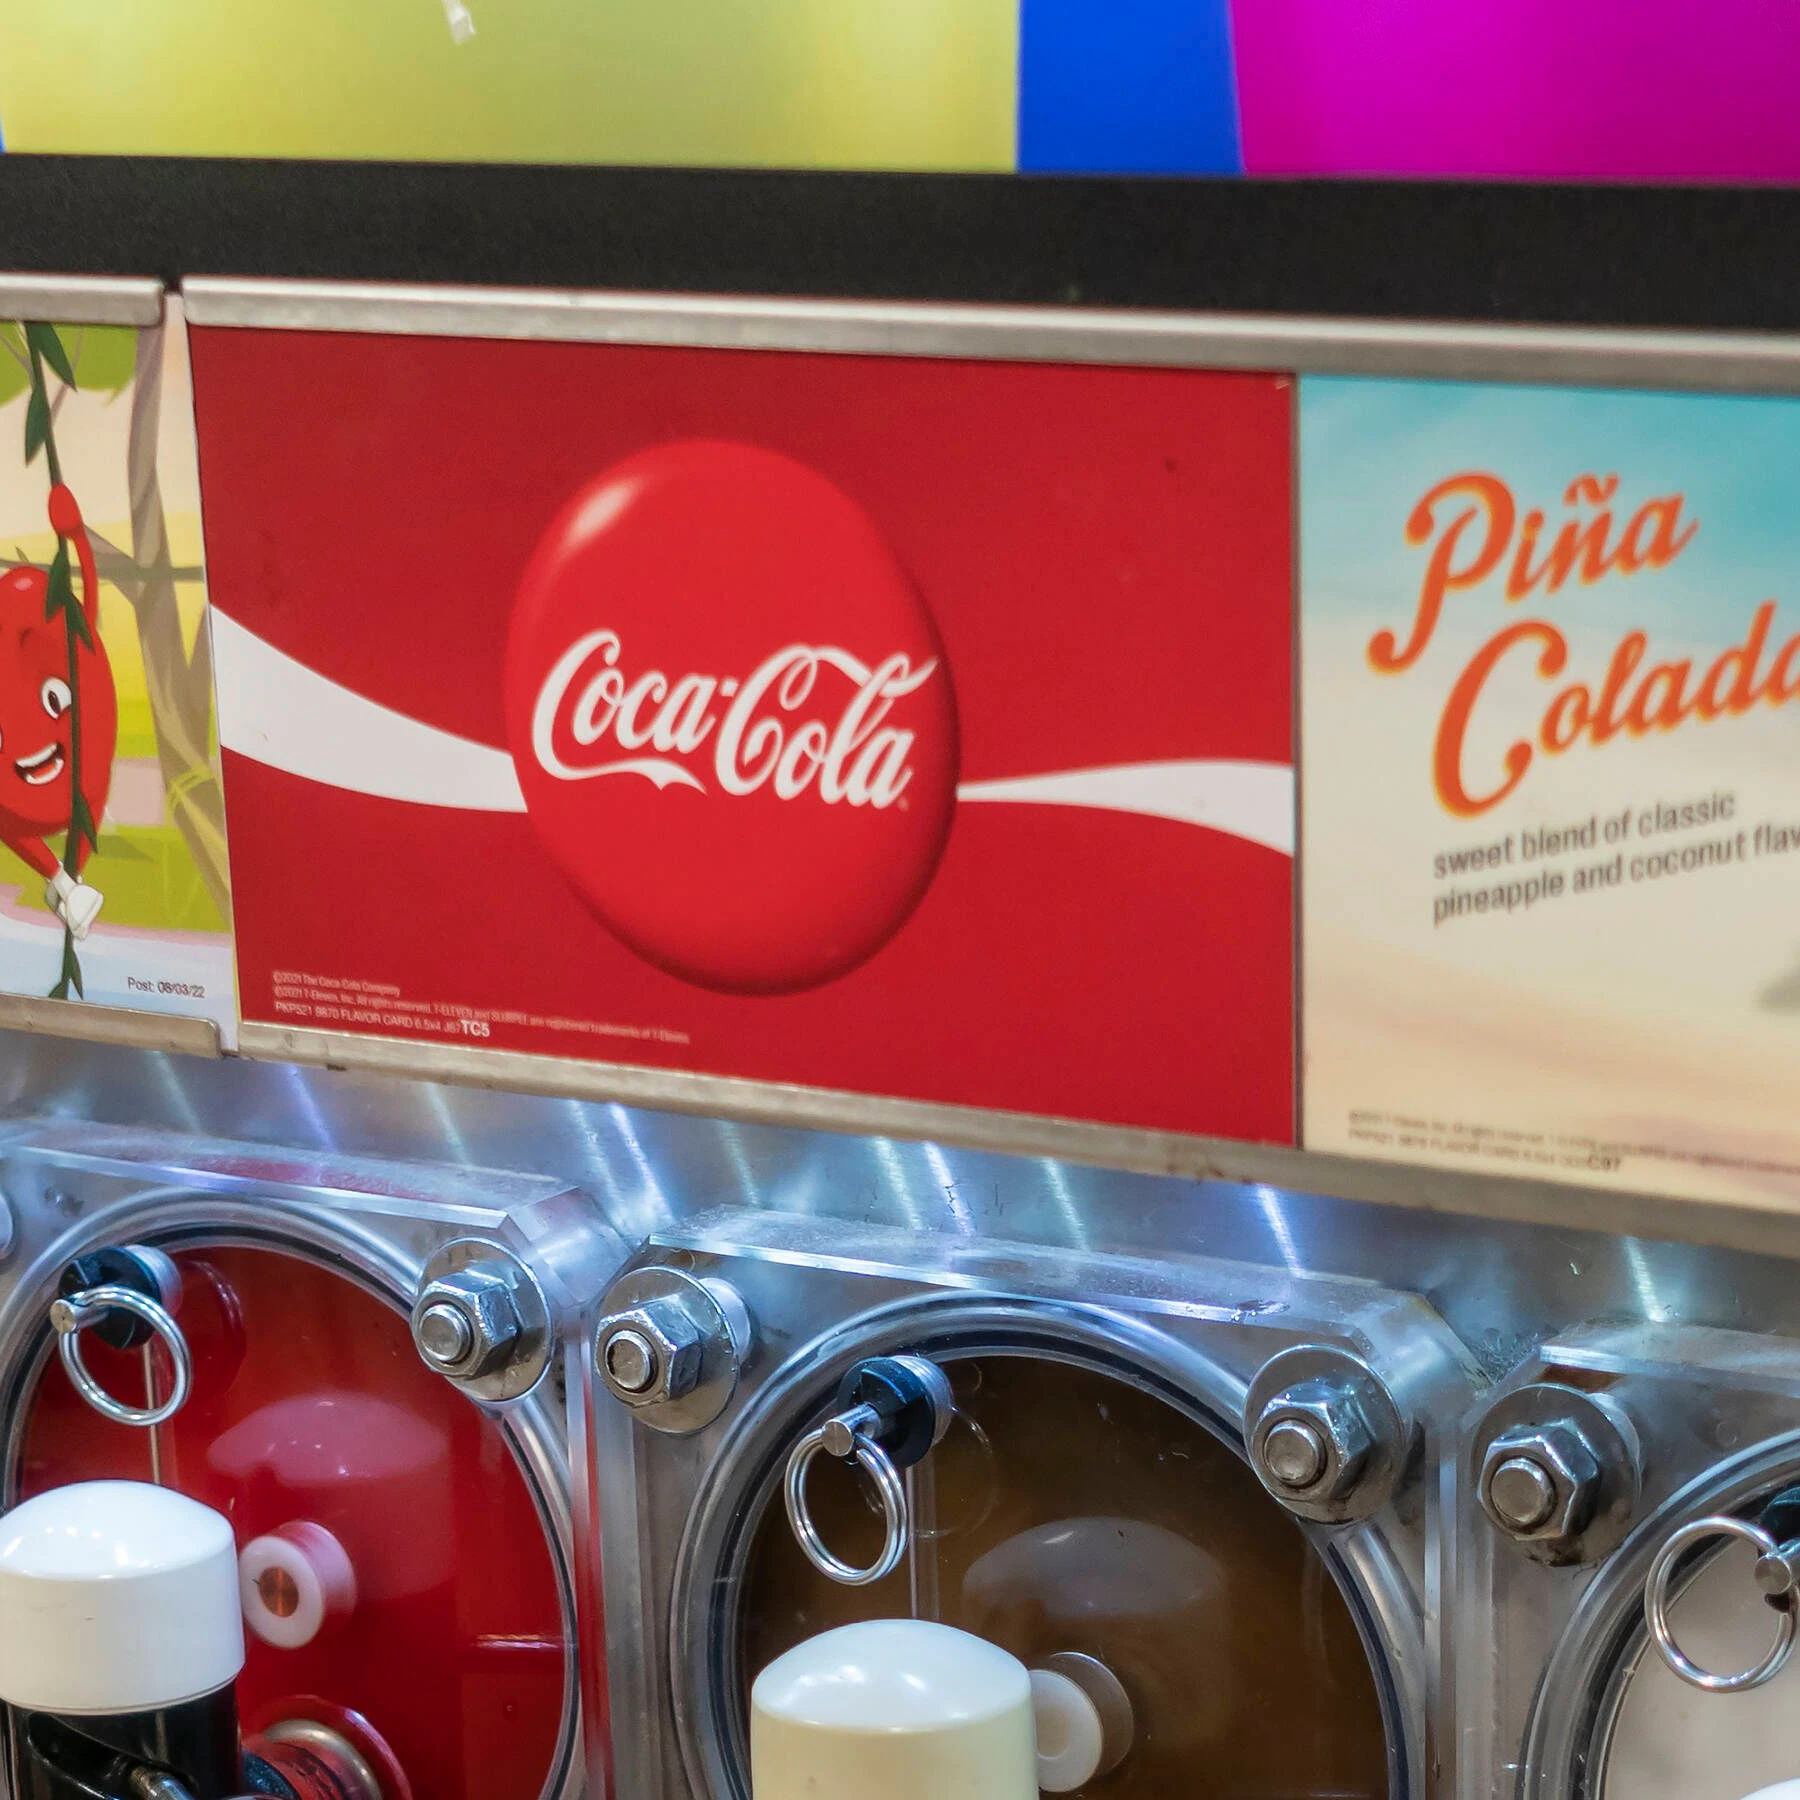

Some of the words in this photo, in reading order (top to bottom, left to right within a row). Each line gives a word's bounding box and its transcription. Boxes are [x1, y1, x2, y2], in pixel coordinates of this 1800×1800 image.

[1367, 469, 1700, 674] Piña
[532, 628, 939, 809] Coca-Cola
[1433, 837, 1514, 879] sweet
[1519, 817, 1597, 858] blend
[1603, 808, 1630, 842] of
[1638, 790, 1736, 838] classic
[1433, 868, 1564, 928] pineapple
[1572, 856, 1623, 895] and
[1629, 835, 1745, 884] coconut
[341, 1008, 382, 1026] FLAVOR
[383, 1014, 413, 1029] CARD
